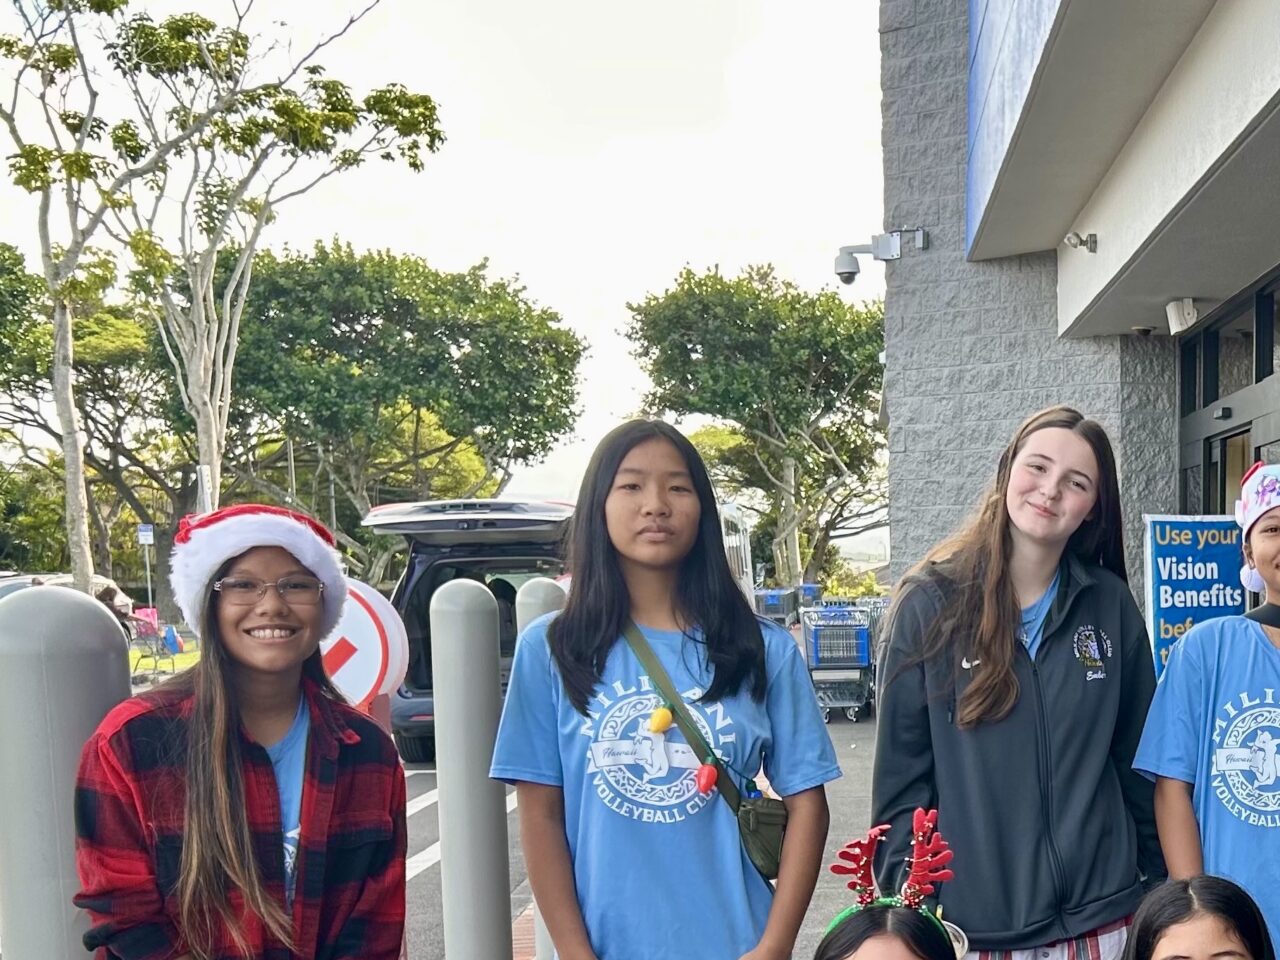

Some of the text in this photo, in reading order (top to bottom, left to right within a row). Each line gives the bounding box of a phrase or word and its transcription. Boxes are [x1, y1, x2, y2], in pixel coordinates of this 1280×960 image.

[1155, 525, 1239, 549] Use your
[1157, 556, 1218, 580] Vision
[1159, 583, 1242, 608] Benefits
[581, 675, 736, 745] MILIANI
[592, 774, 685, 823] VOLLEYBALL
